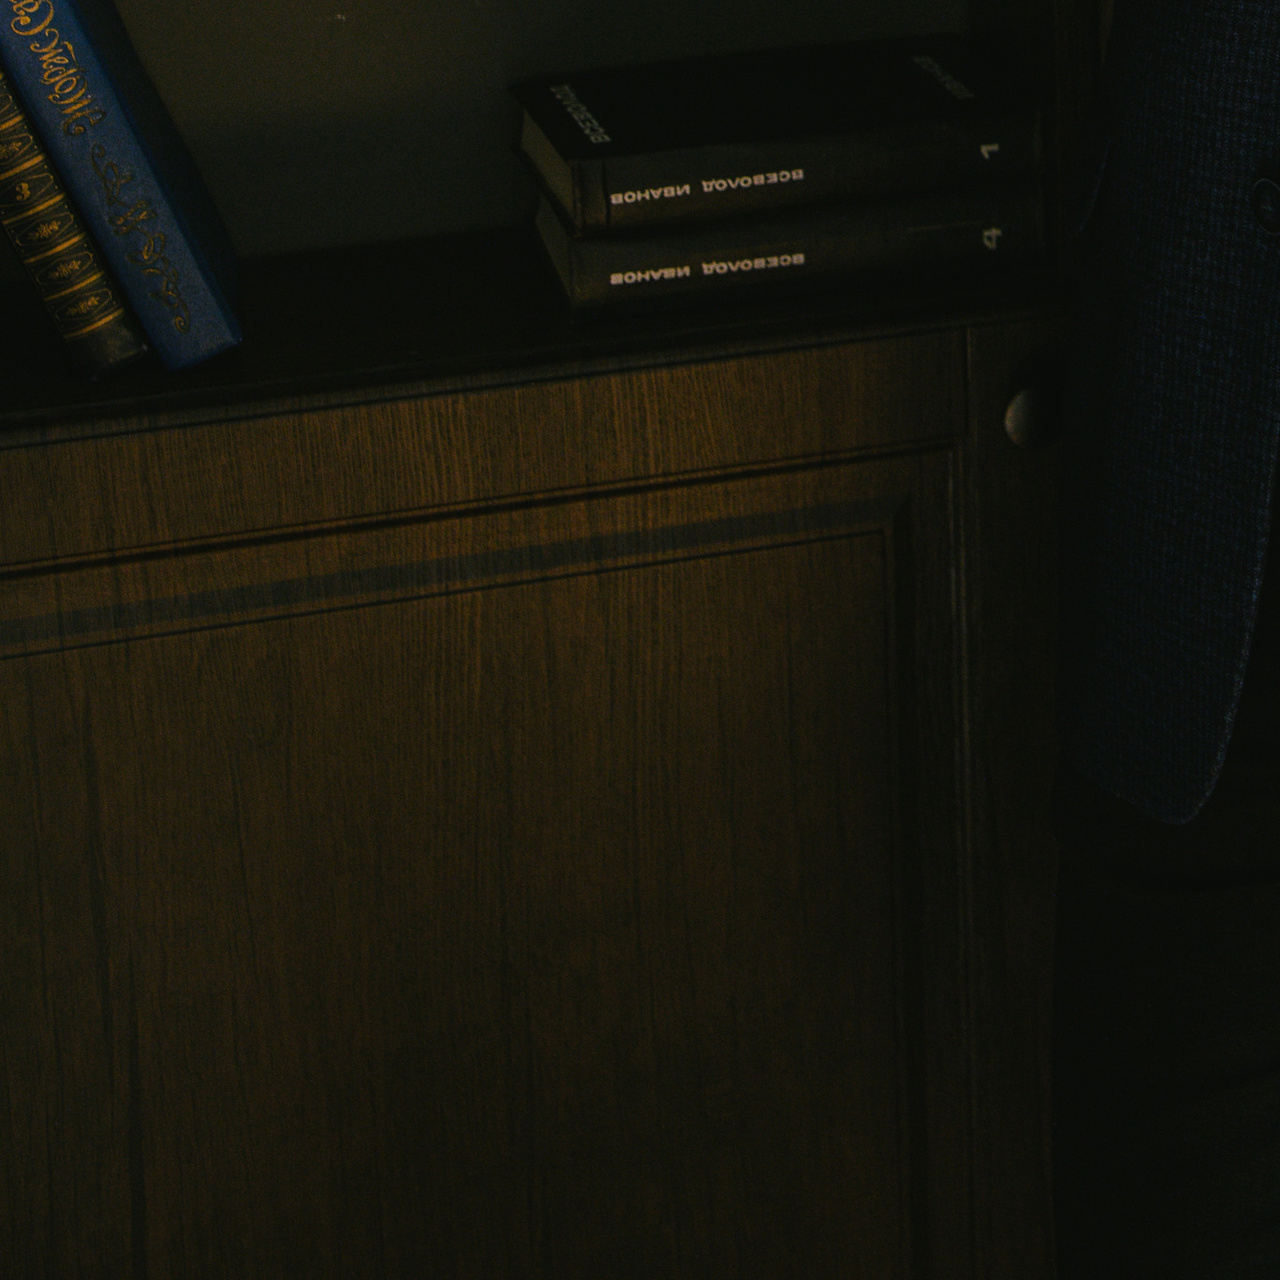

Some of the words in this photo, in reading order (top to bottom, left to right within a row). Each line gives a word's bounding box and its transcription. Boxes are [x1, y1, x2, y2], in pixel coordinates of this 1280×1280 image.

[980, 144, 999, 159] 1
[702, 169, 804, 194] ВСЕВОЛОД
[611, 183, 691, 205] ИВАНОВ
[982, 227, 1001, 249] 4
[702, 253, 805, 275] ВСЕВОЛОД
[610, 265, 691, 286] ИВАНОВ
